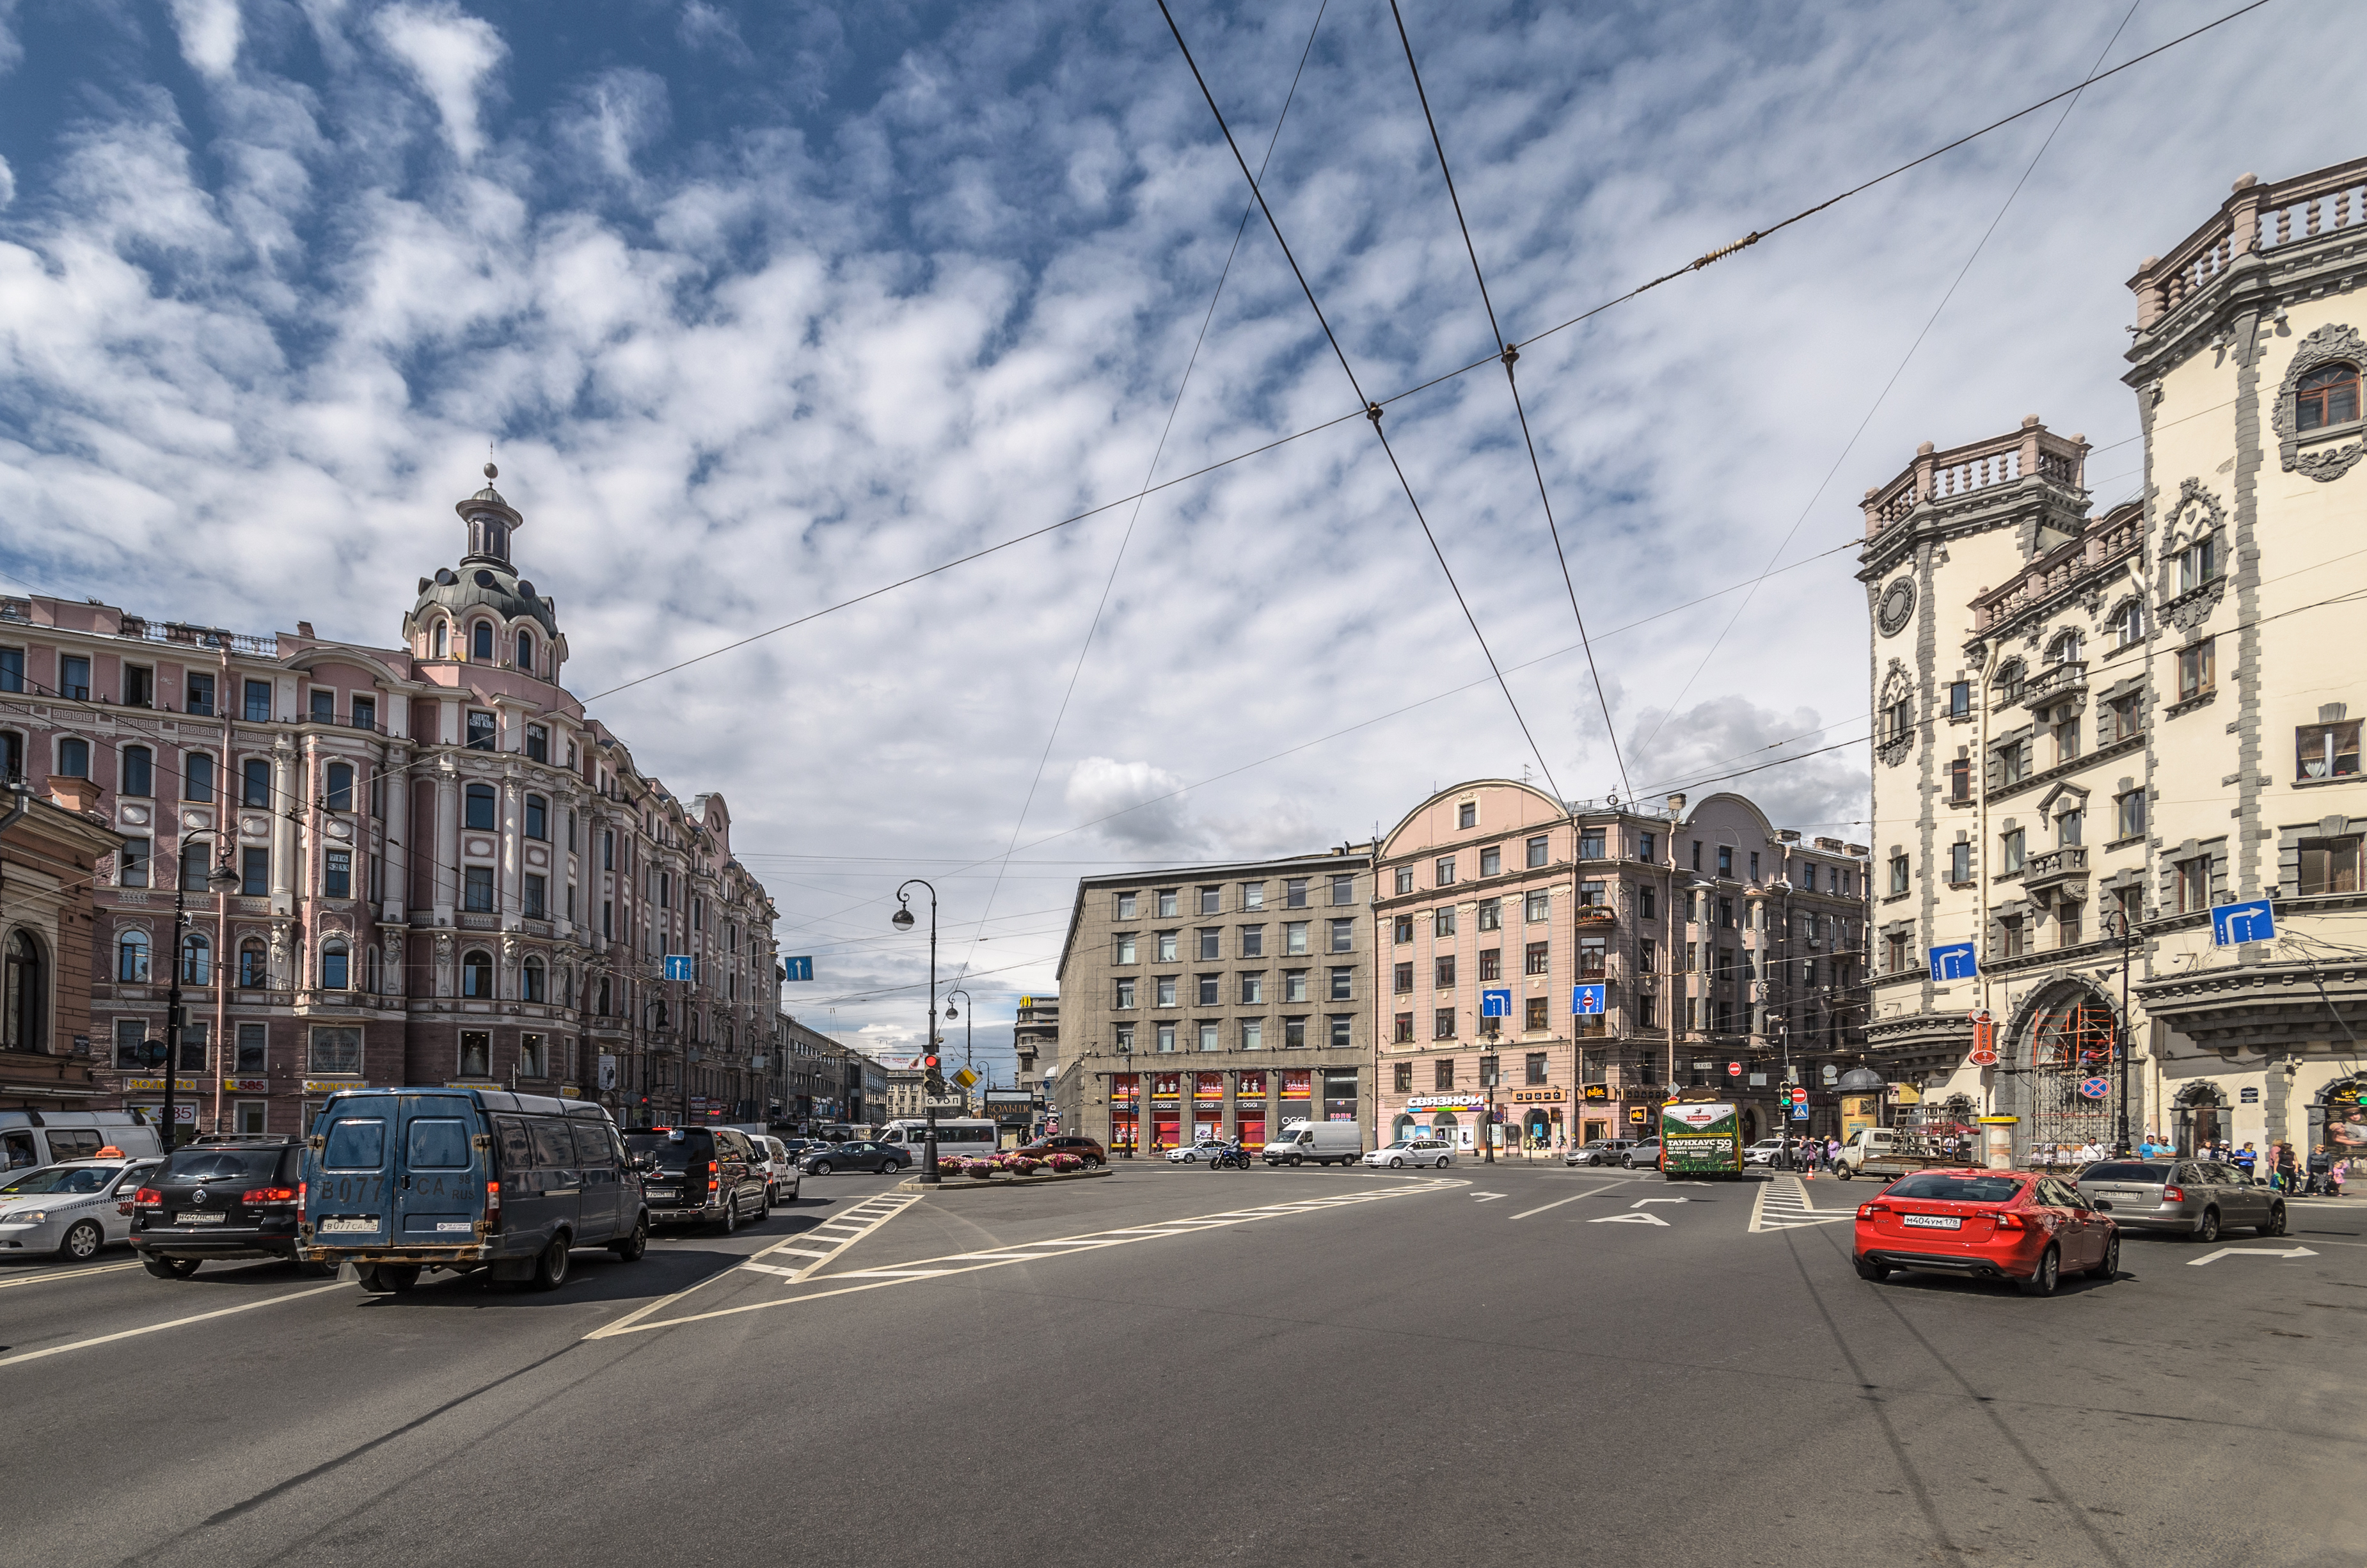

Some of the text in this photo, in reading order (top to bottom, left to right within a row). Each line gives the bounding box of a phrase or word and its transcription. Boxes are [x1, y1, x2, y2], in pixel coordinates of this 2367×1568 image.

[239, 1081, 264, 1090] 585
[306, 1082, 365, 1091] ЗОЛОТО
[1587, 1086, 1605, 1097] enter
[928, 1097, 959, 1105] СТОП
[1407, 1093, 1484, 1107] СВЯЗНОЙ
[1281, 1116, 1306, 1125] OGGI
[1716, 1139, 1732, 1148] 59
[458, 1174, 471, 1184] 98
[321, 1176, 445, 1203] В077 СА
[452, 1189, 475, 1200] RUS
[178, 1212, 210, 1221] Н447НС
[326, 1221, 363, 1231] В077СА
[1906, 1217, 1942, 1226] М404УМ
